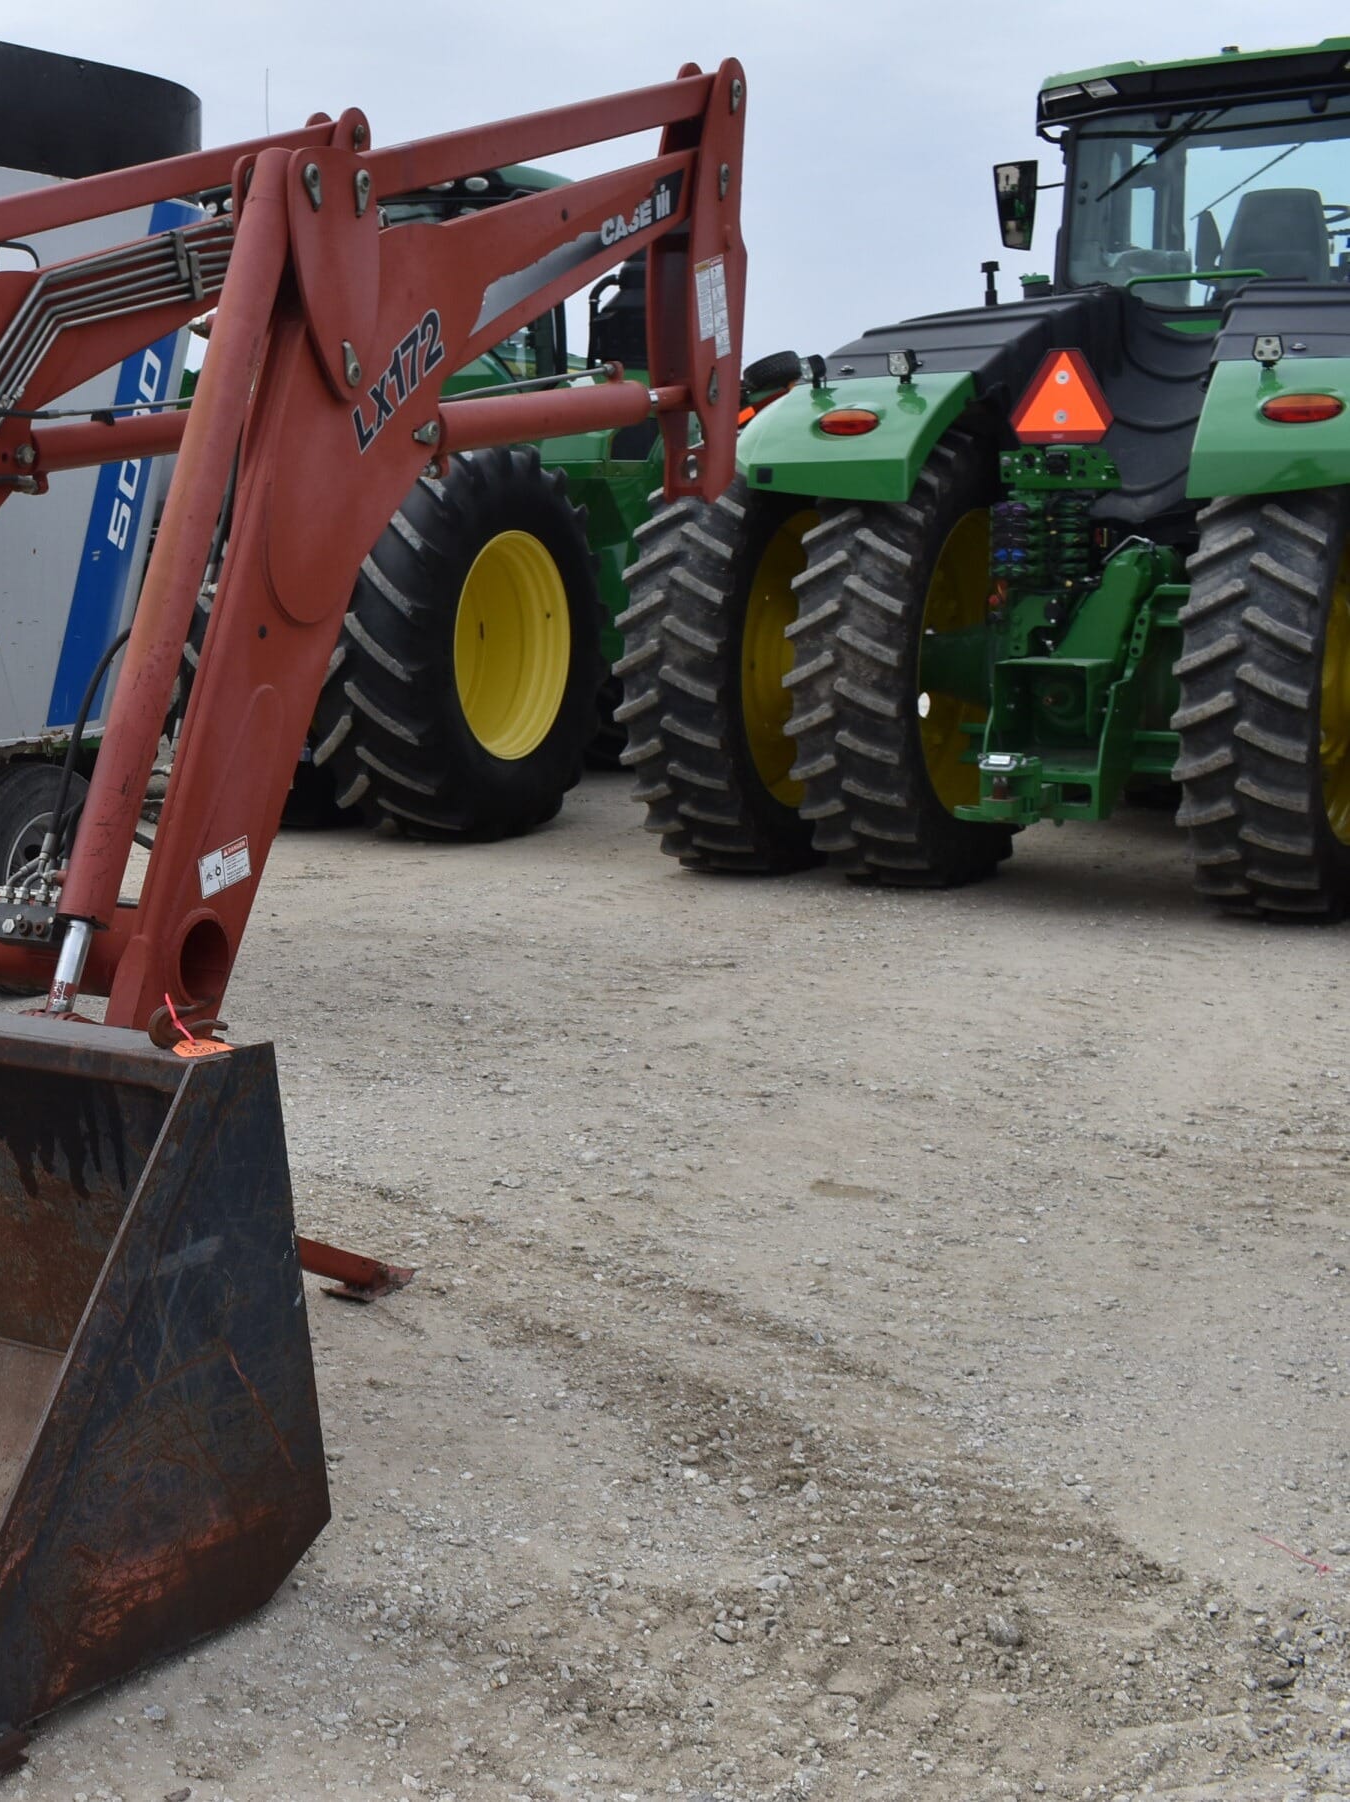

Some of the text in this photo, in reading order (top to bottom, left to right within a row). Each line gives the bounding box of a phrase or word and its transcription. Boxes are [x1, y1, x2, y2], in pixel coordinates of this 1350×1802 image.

[601, 198, 652, 246] CASE
[107, 348, 162, 551] 500
[352, 308, 445, 455] LX172
